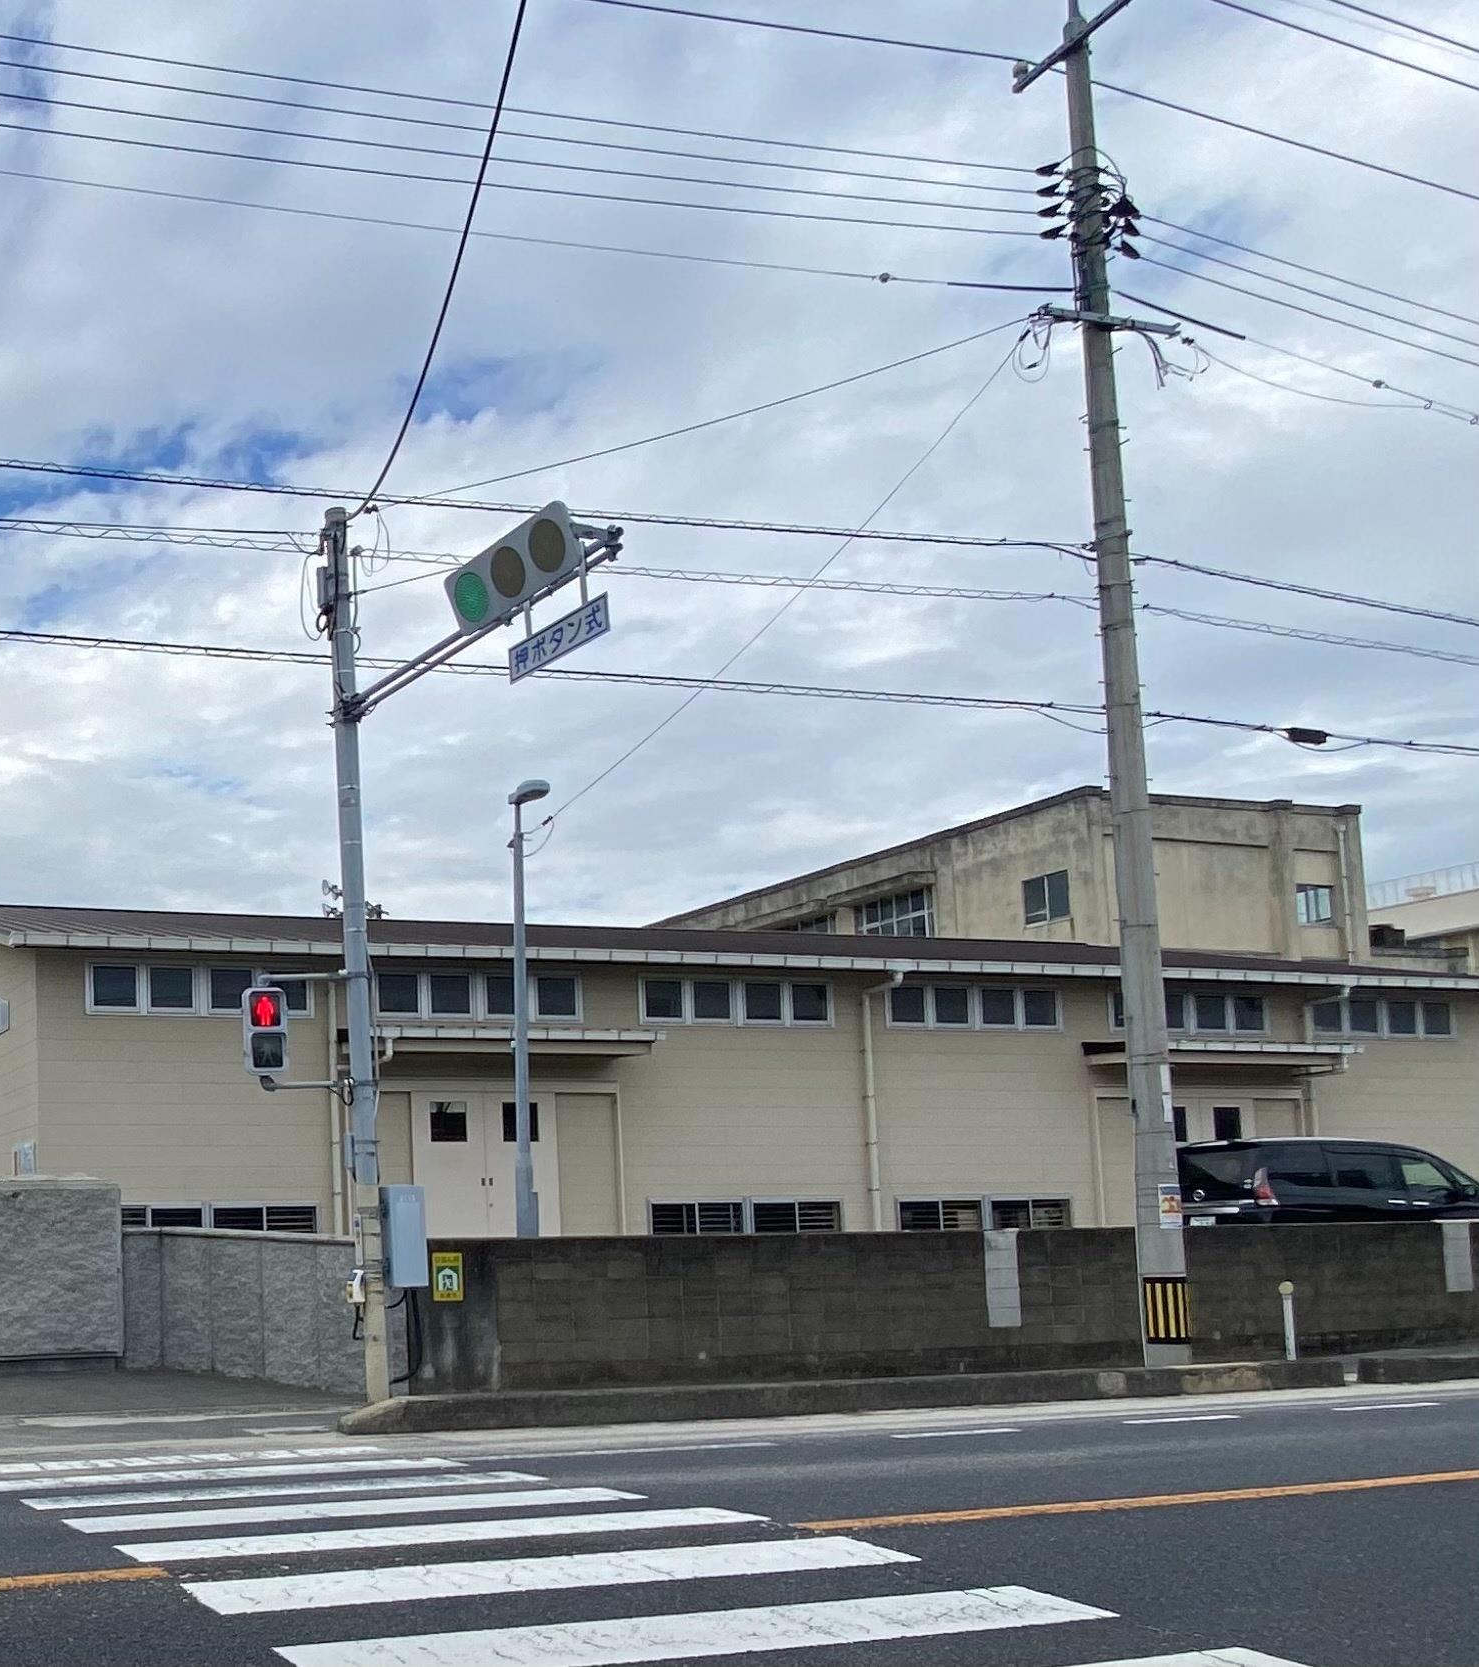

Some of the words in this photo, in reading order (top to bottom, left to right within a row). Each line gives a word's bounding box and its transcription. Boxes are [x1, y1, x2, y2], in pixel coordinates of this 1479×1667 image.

[514, 604, 603, 675] 押ボタン式
